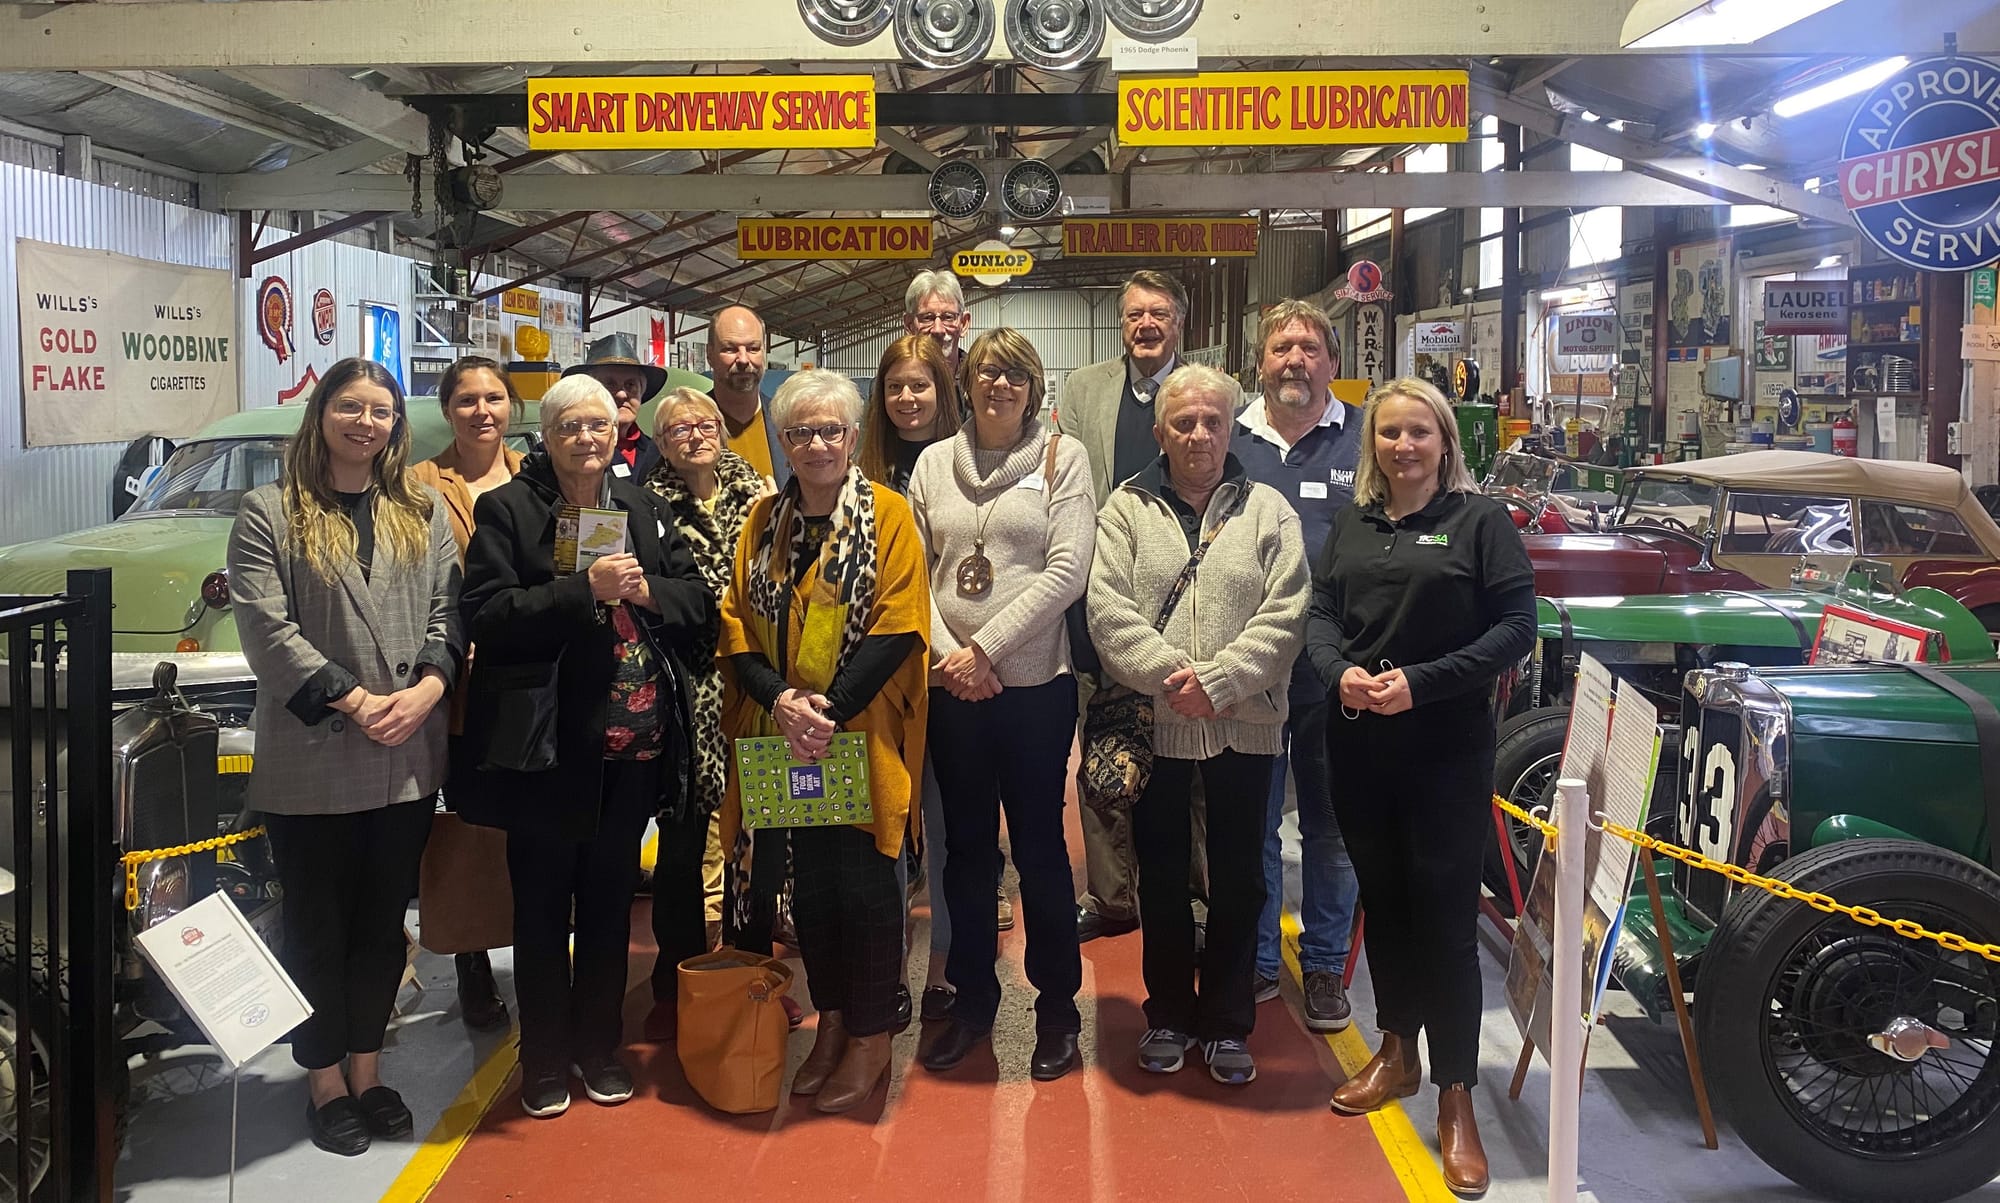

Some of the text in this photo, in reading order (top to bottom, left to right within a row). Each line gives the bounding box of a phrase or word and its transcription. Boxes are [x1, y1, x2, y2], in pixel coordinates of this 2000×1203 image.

[1120, 46, 1137, 54] 1965
[1138, 46, 1160, 54] Dodge
[532, 90, 870, 133] SMART DRIVEWAY SERVICE
[1126, 84, 1466, 131] SCIENTIFIC LUBRICATION
[742, 226, 929, 251] LUBRICATION
[1065, 223, 1258, 252] TRAILER FOR HIRE
[958, 254, 1028, 267] DUNLOP
[1358, 264, 1373, 292] S
[1361, 289, 1394, 301] SERVICE
[1768, 290, 1848, 308] LAUREL
[1565, 317, 1613, 334] UNION
[1780, 310, 1838, 320] Kerosene
[40, 327, 97, 354] GOLD
[121, 331, 229, 362] WOODBINE
[1421, 335, 1461, 344] Mobiloil
[1362, 310, 1378, 400] WARATA
[32, 365, 105, 391] FLAKE
[150, 375, 206, 391] CIGARETTES
[813, 776, 821, 788] ART
